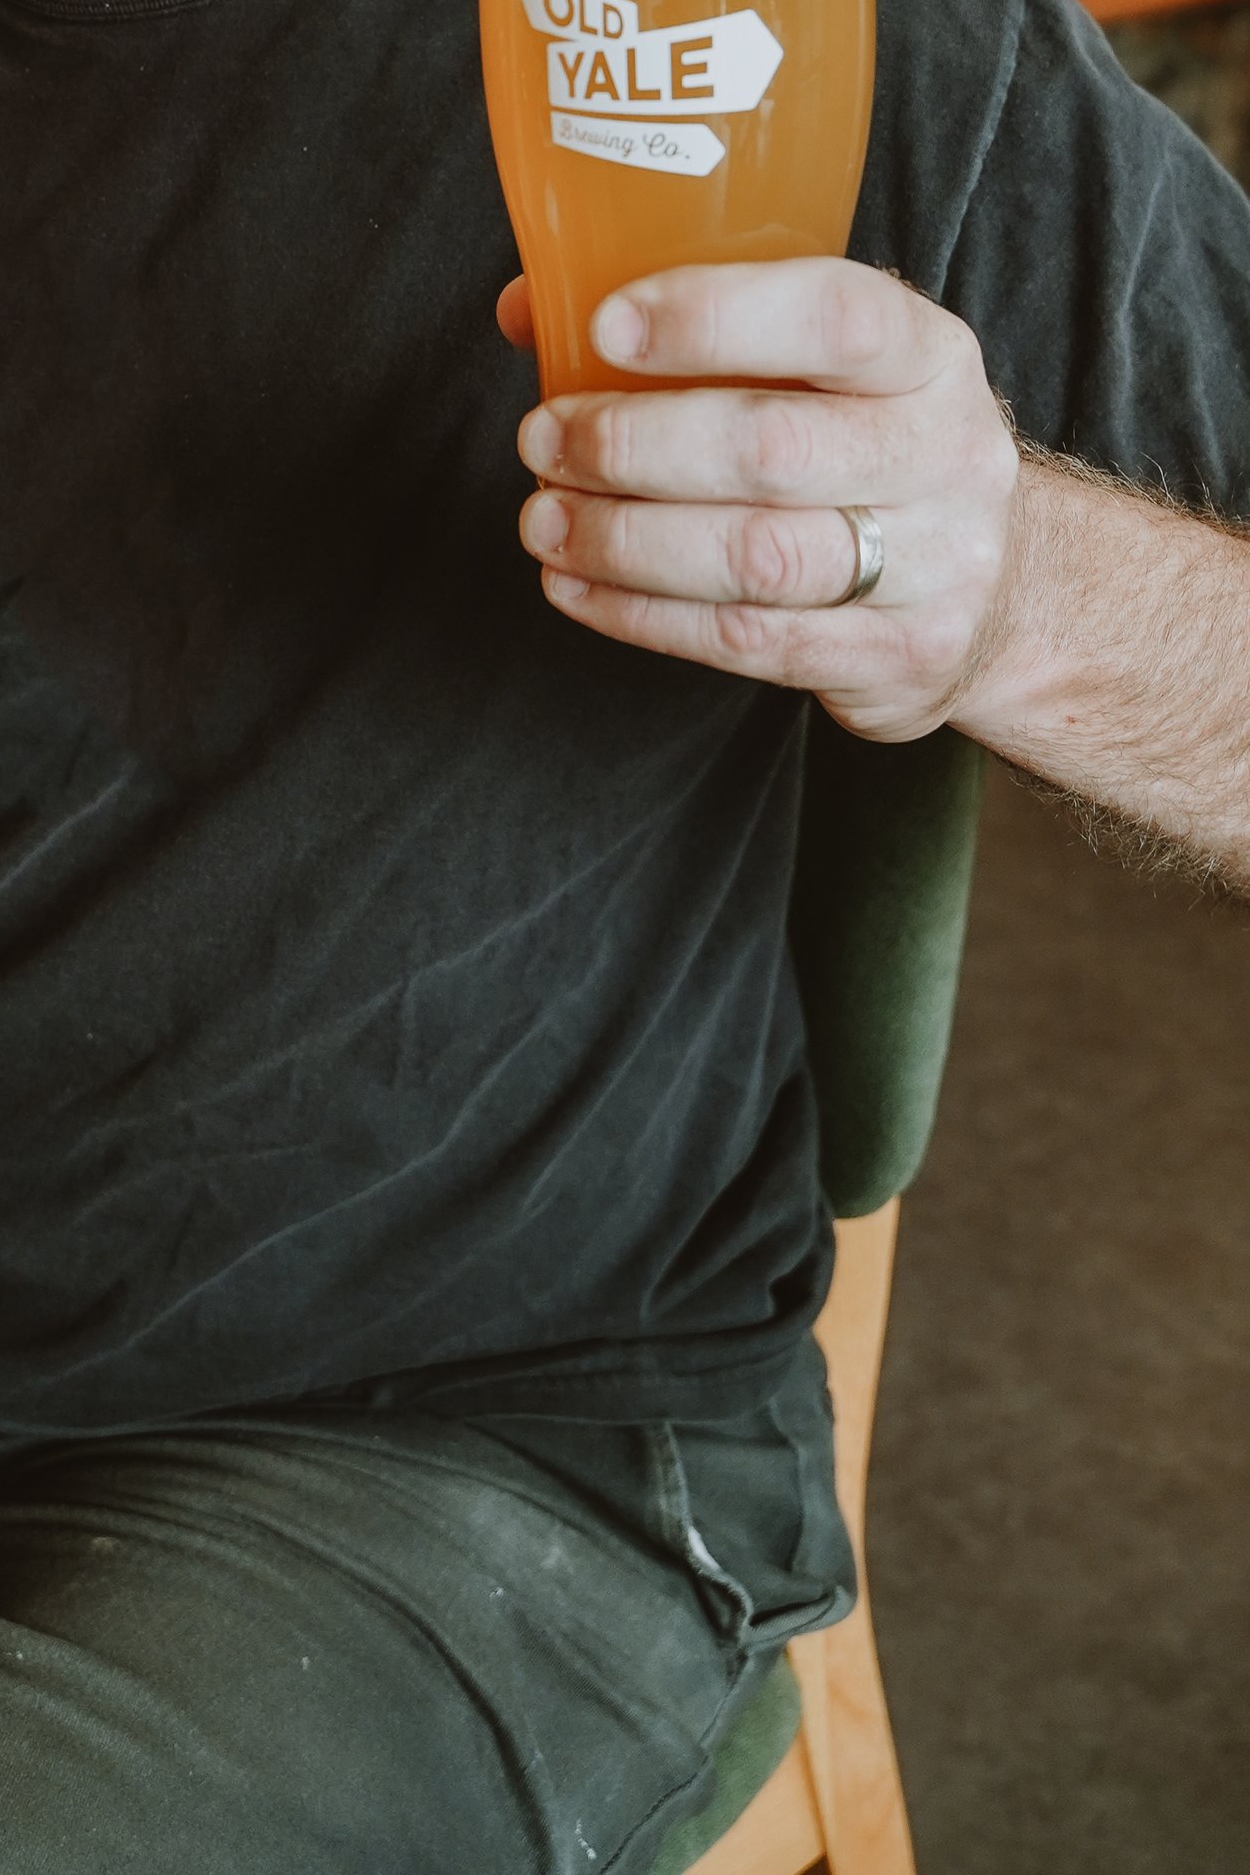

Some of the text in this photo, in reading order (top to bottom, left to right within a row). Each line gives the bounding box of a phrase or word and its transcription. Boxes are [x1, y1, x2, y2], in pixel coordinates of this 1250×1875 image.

[558, 36, 714, 100] YALE
[559, 120, 690, 159] Brewing Co.
